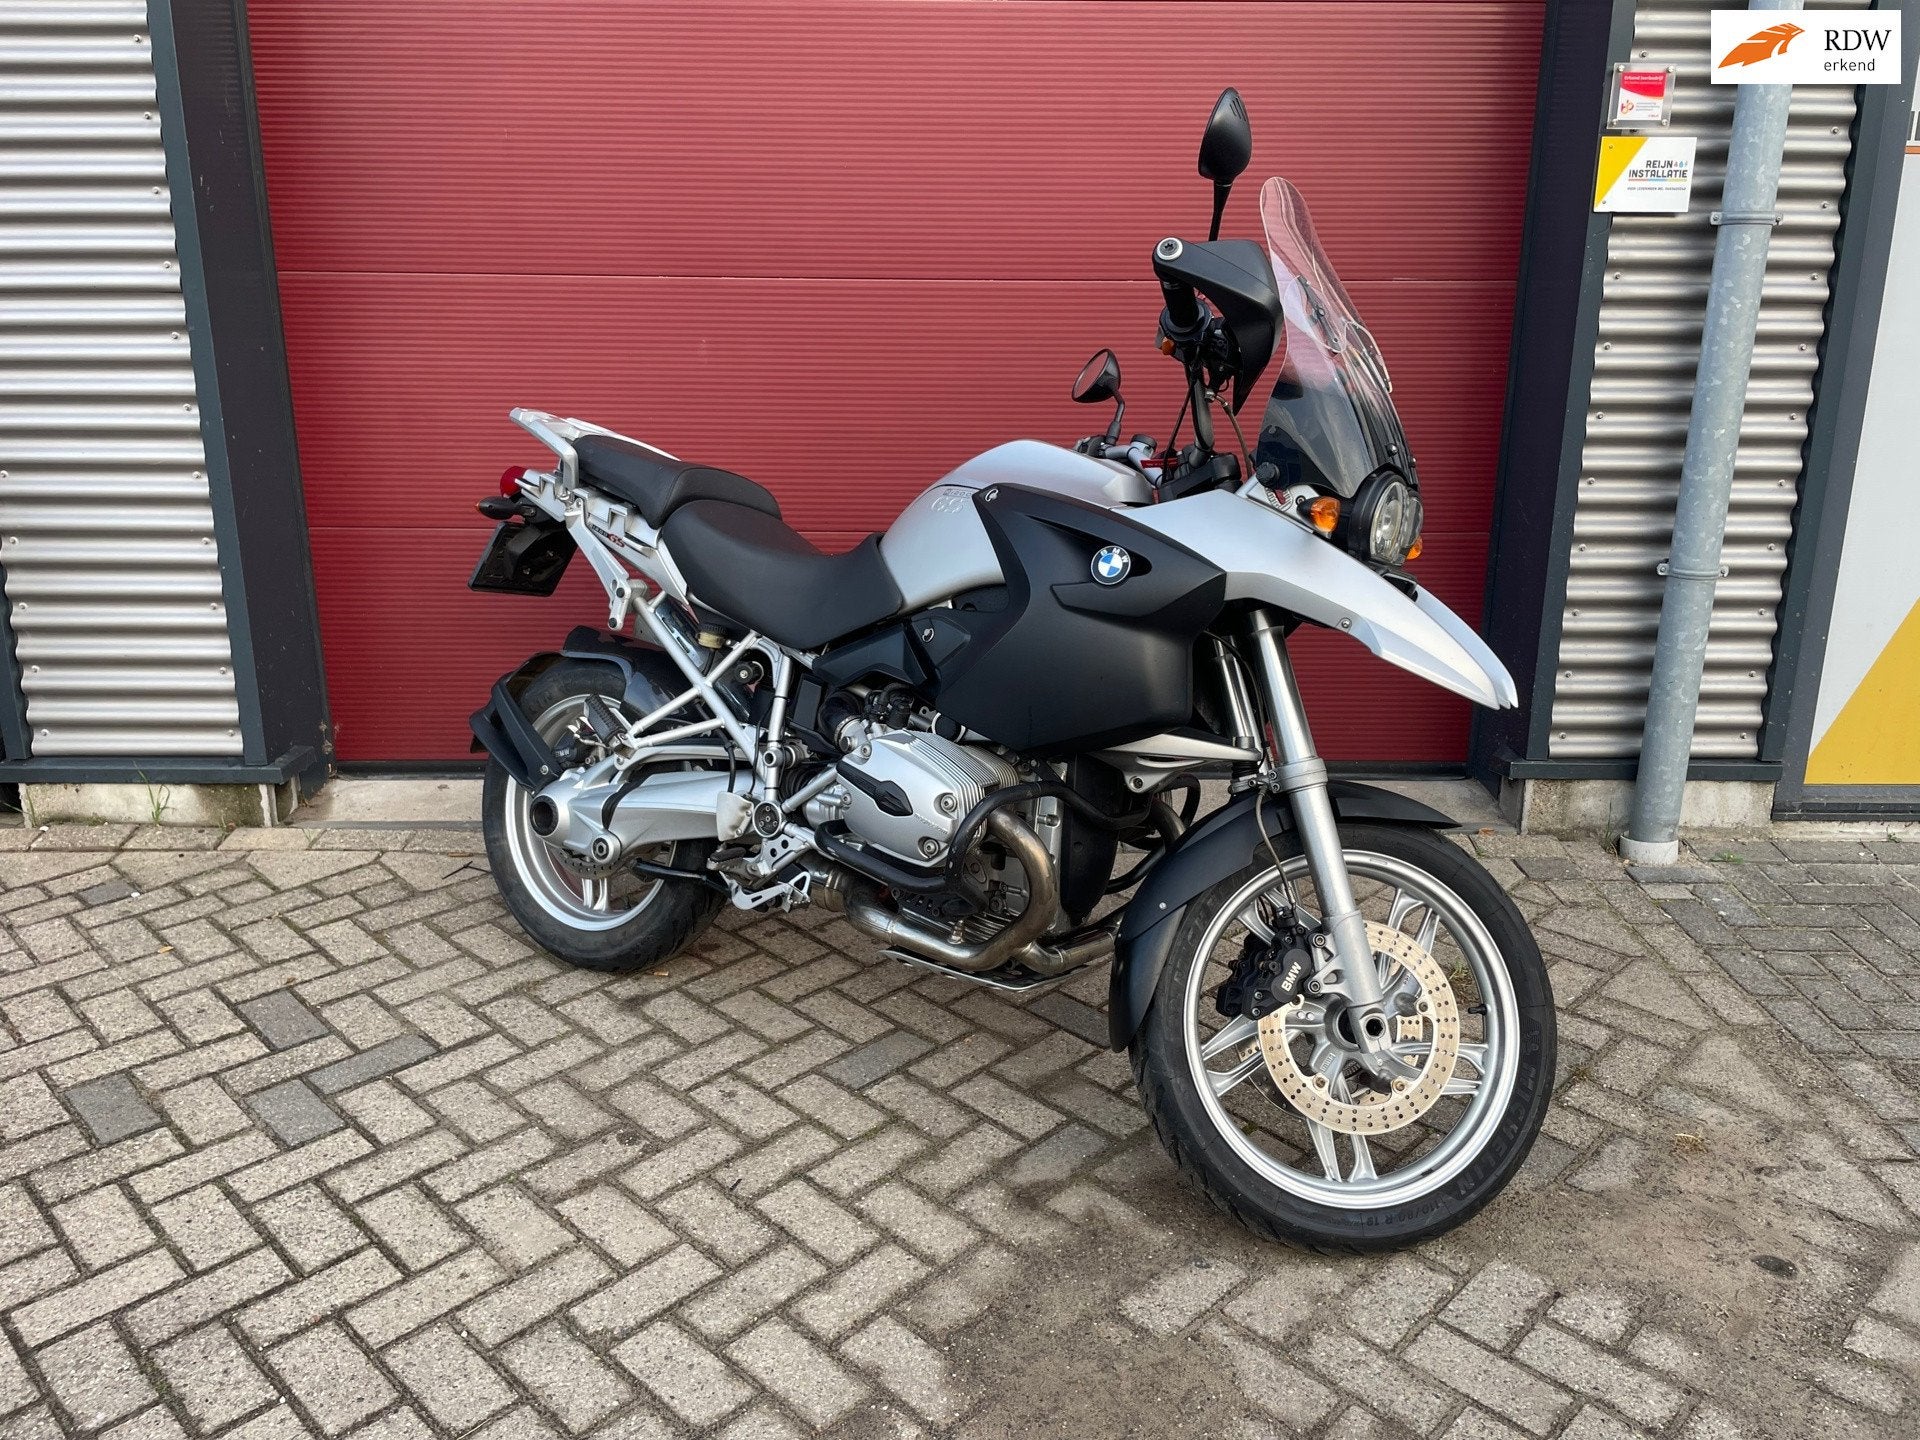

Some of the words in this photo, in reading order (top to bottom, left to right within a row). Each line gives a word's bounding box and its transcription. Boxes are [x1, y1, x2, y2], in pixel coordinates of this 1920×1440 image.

[1645, 159, 1673, 169] REIJN
[1628, 169, 1688, 178] INSTALLATIE
[1100, 547, 1129, 563] BMW
[1281, 961, 1302, 992] BMW
[1456, 1064, 1537, 1196] MICHELIN
